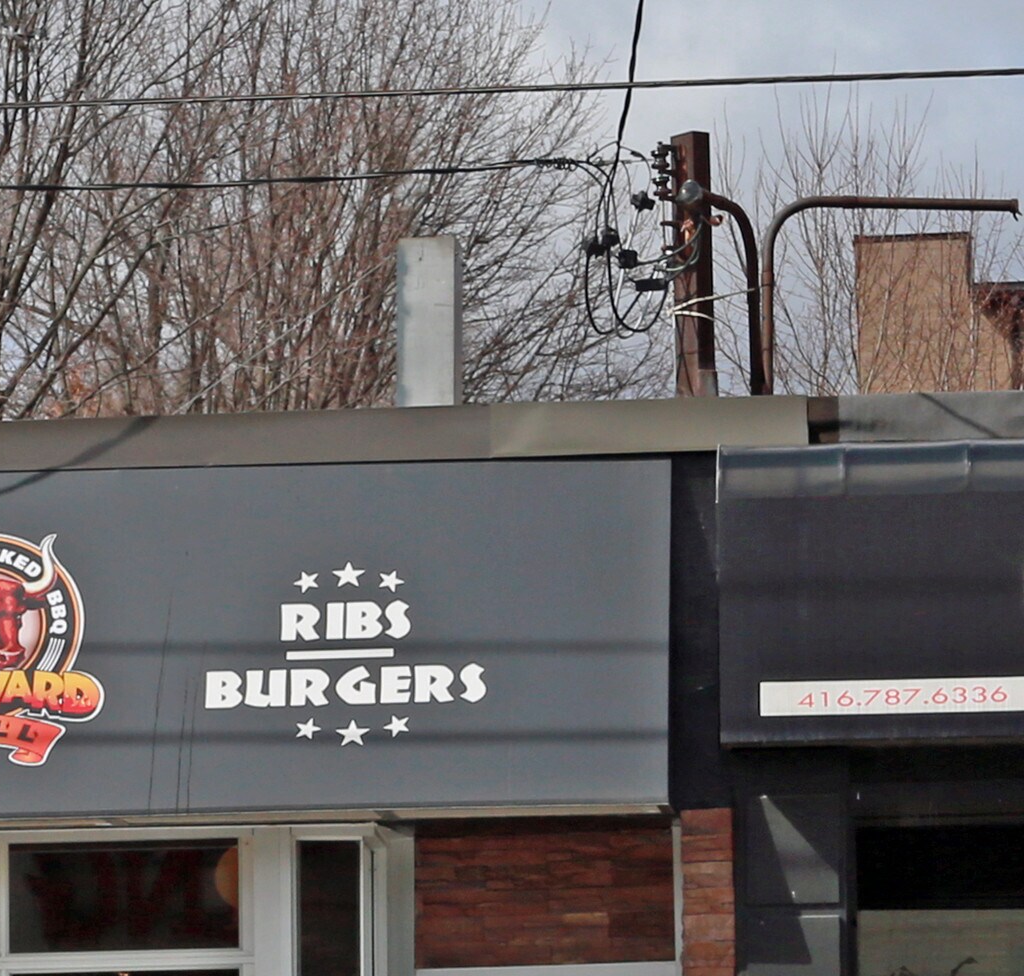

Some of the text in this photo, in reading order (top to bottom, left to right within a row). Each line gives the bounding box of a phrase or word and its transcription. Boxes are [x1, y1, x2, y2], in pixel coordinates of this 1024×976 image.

[46, 588, 68, 635] BBQ
[280, 599, 412, 642] RIBS
[204, 662, 487, 709] BURGERS
[797, 686, 1009, 708] 416.787.6336
